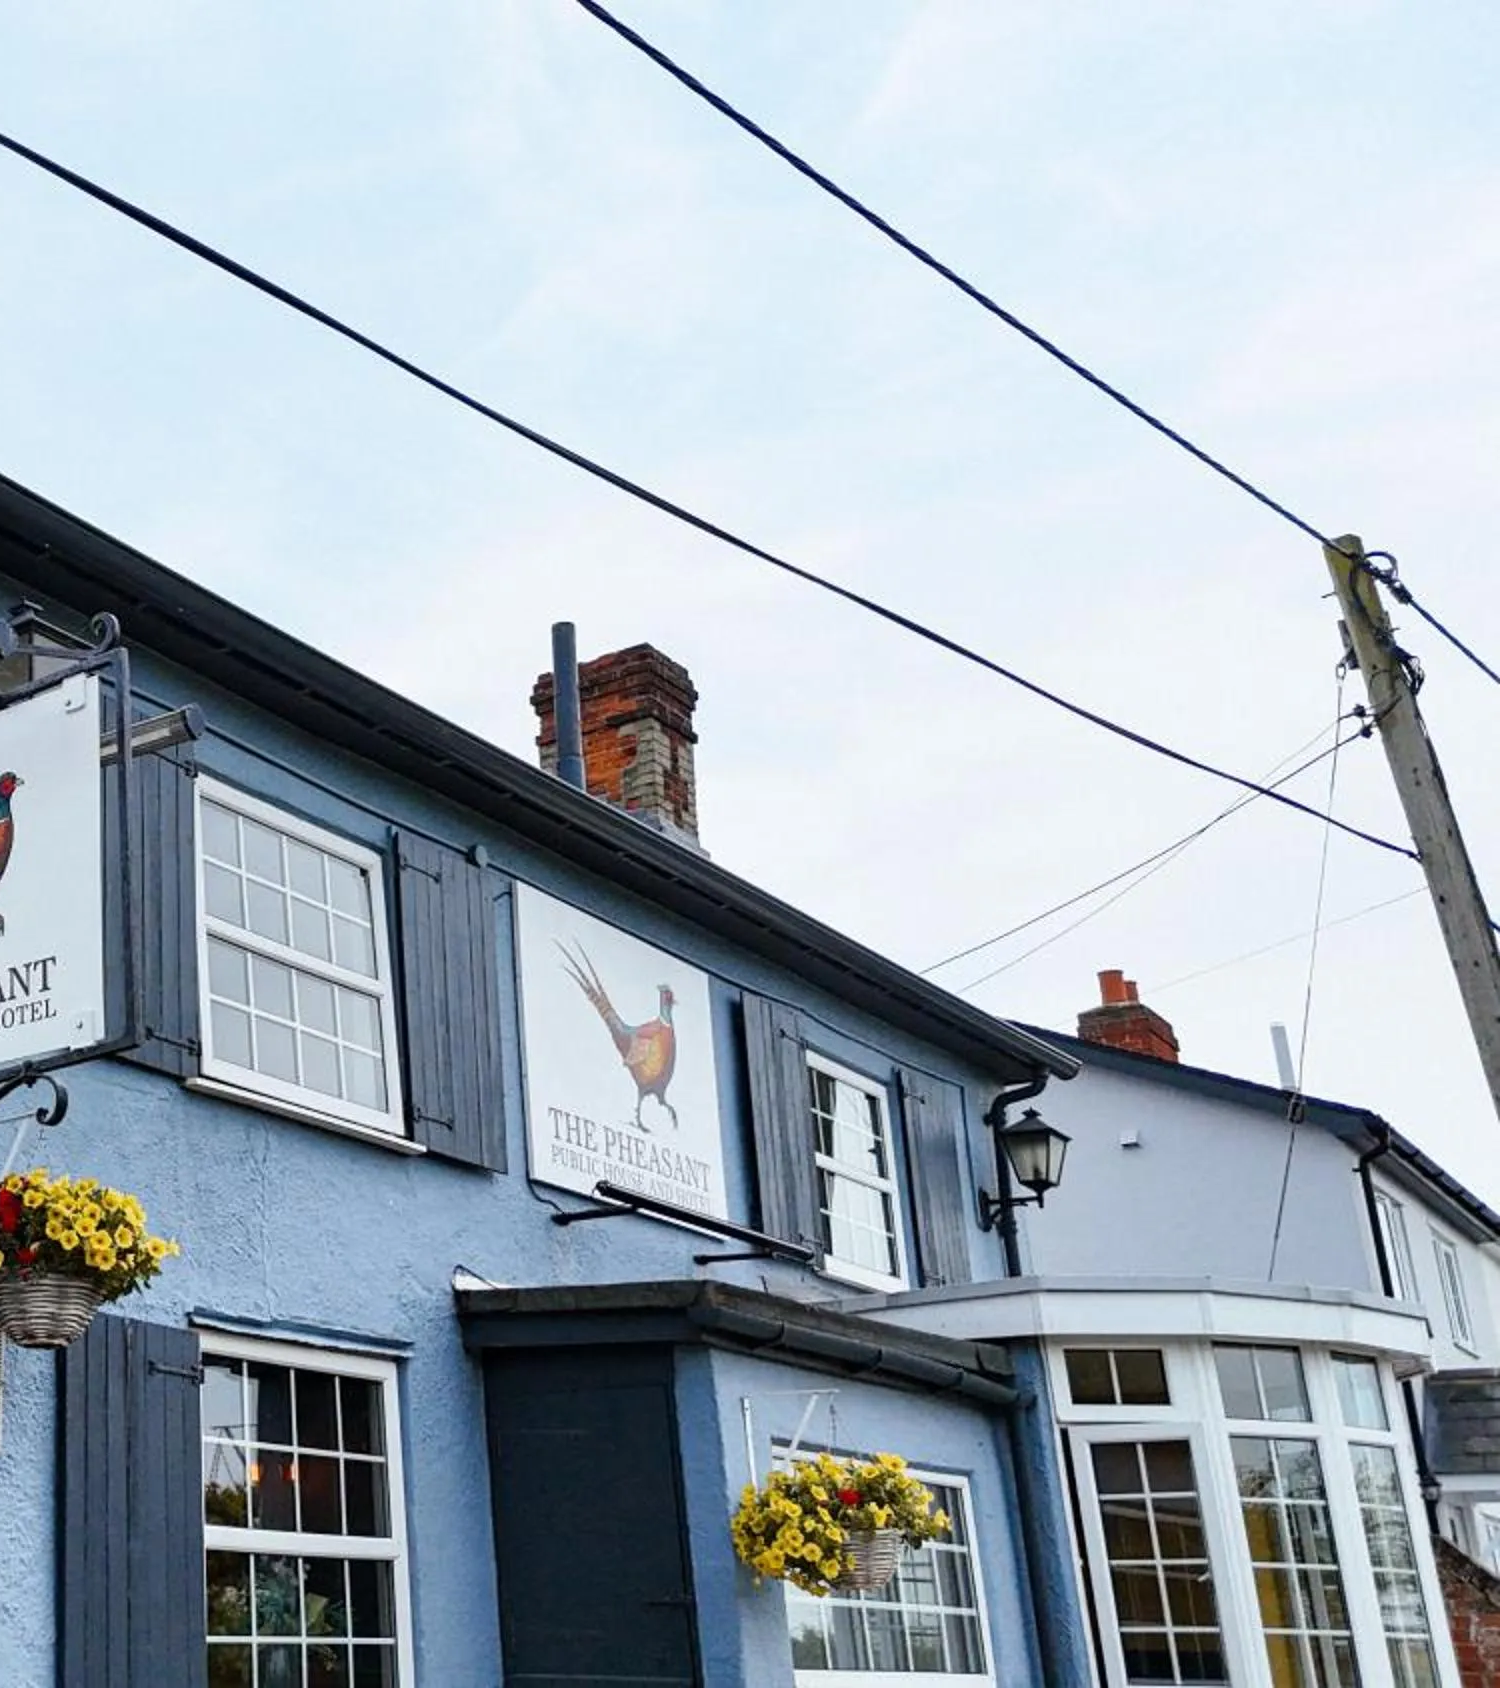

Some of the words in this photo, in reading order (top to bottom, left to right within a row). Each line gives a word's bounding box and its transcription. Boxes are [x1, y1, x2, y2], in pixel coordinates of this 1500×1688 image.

[548, 1107, 599, 1153] THE
[602, 1125, 711, 1193] PHEASANT
[551, 1143, 601, 1177] PUBLIC
